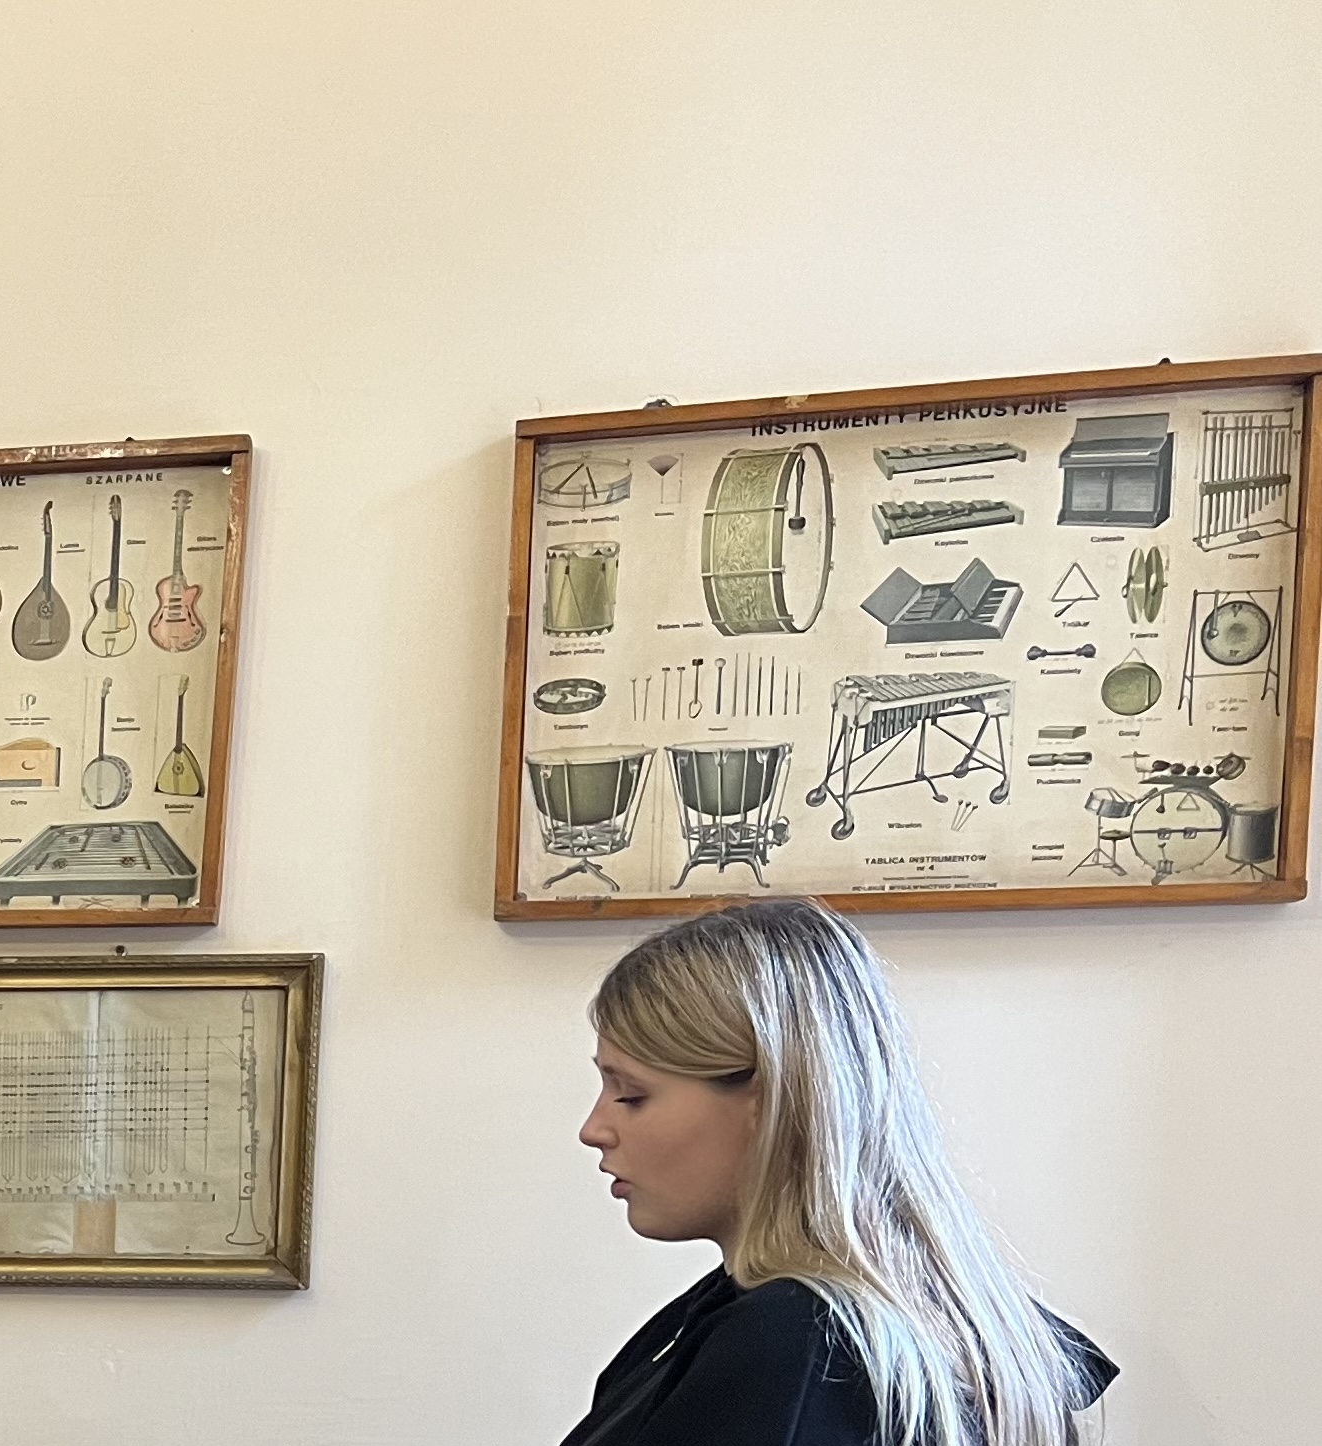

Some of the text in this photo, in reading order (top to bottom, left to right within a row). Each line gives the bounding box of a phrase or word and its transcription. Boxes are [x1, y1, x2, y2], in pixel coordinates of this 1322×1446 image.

[751, 400, 1068, 437] INSTRUMENTY PERKUSYJNE
[85, 472, 164, 486] SZARPANE
[864, 853, 988, 865] TABLICA INSTRUMENTÓW
